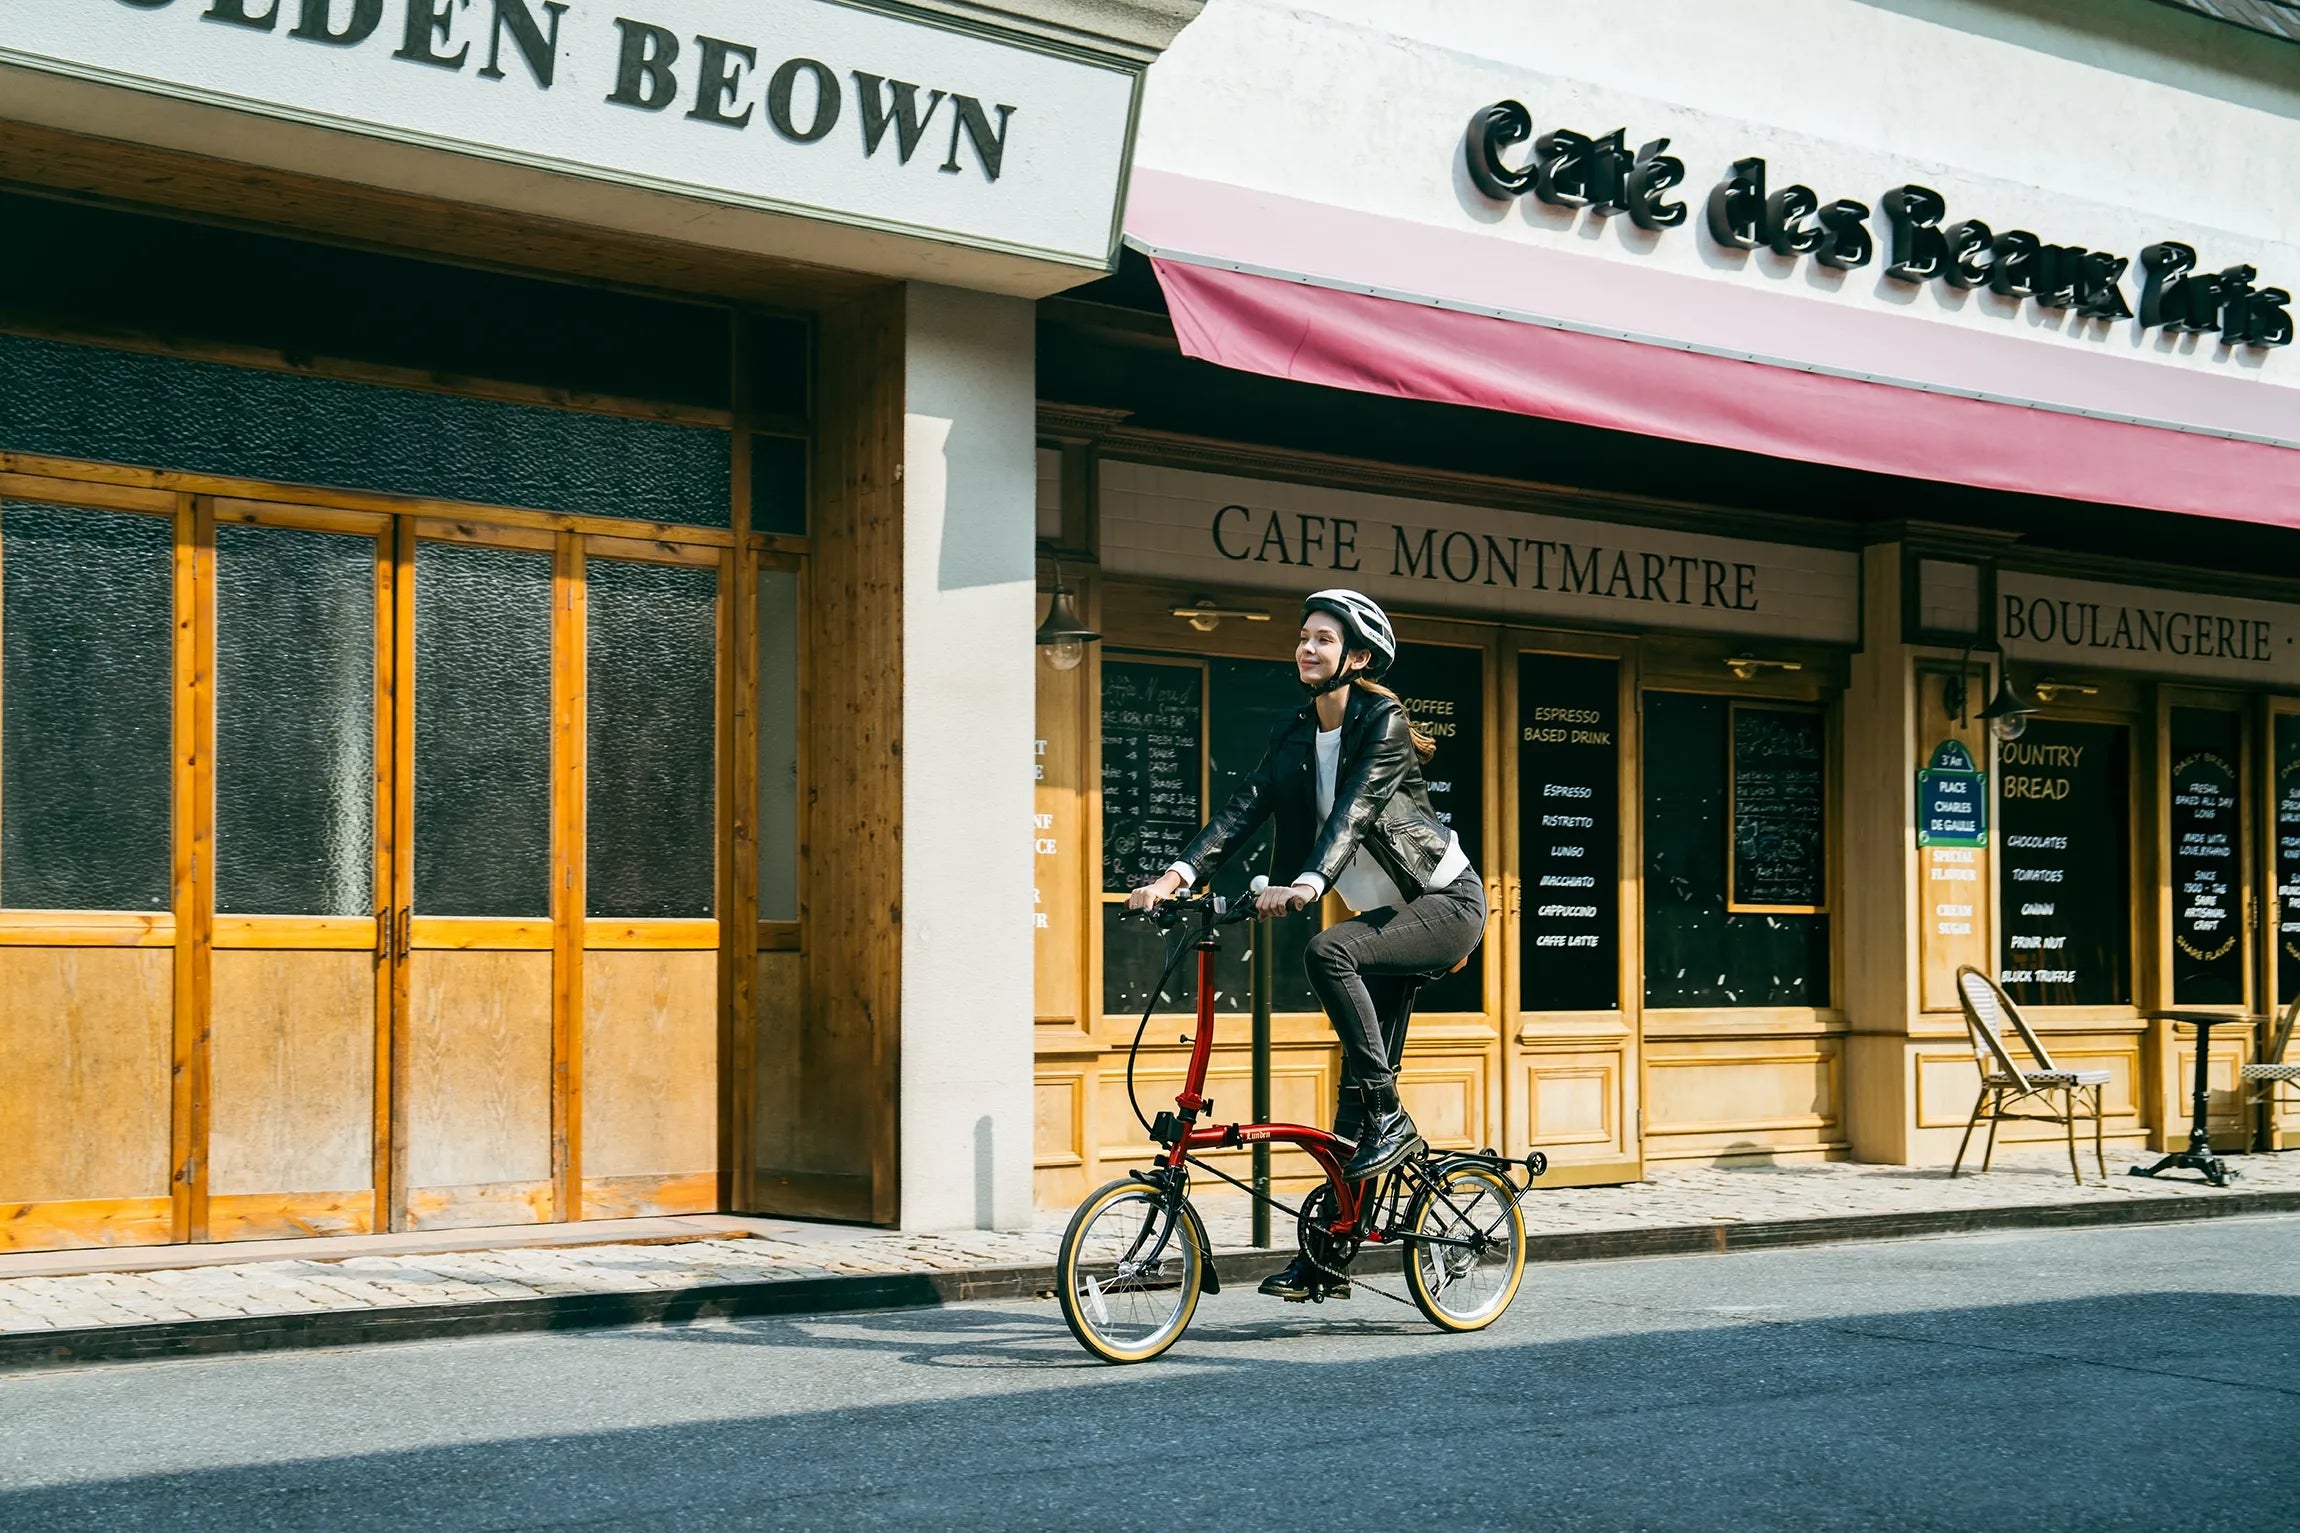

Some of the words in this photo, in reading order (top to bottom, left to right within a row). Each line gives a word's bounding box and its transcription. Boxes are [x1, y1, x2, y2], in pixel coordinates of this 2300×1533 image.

[112, 0, 569, 90] DEN
[606, 17, 1016, 181] BEOWN
[1707, 156, 1874, 272] des
[1882, 183, 2134, 322] Beaux
[1211, 504, 1362, 572] CAFE
[1389, 525, 1758, 612] MONTMARTRE
[2003, 594, 2272, 662] BOULANGERIE
[1403, 698, 1455, 716] COFFEE
[1535, 708, 1599, 723] ESPRESSO
[1524, 728, 1567, 742] BASED
[1571, 730, 1610, 744] DRINK
[1544, 784, 1591, 798] ESPRESSO
[1940, 782, 1966, 793] PLACE
[2004, 776, 2069, 800] BREAD
[1935, 801, 1971, 813] CHARLES
[1542, 815, 1593, 827] RISTRETTO
[1930, 818, 1944, 832] DE
[2008, 836, 2067, 849] CHOCOLATES
[1551, 846, 1584, 857] LUNGO
[2012, 869, 2063, 882] TOMATOES
[1538, 905, 1597, 917] CAPPUCCINO
[1536, 936, 1567, 946] CAFFE
[1568, 936, 1599, 947] LATTE
